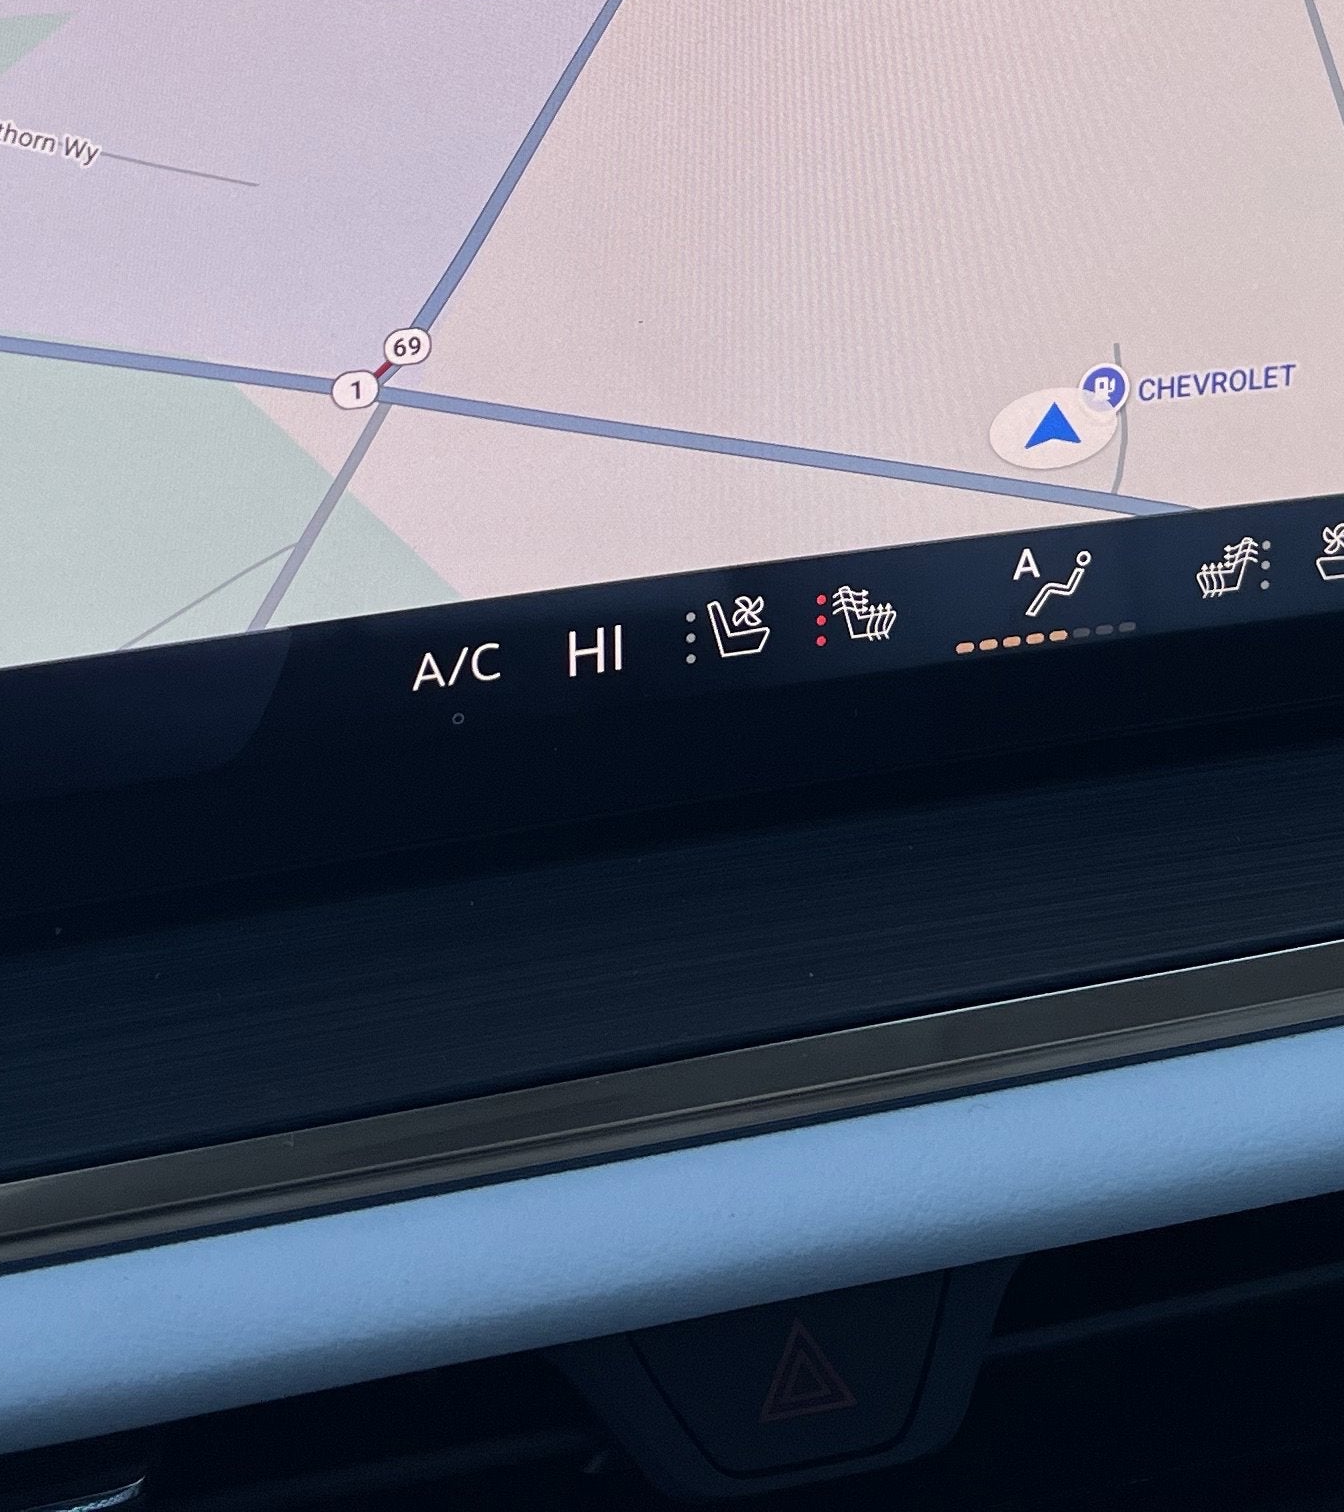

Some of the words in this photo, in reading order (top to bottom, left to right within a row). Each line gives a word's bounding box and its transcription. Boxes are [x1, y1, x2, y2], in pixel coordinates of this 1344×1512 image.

[63, 136, 99, 164] Wy
[393, 336, 422, 358] 69
[1137, 364, 1296, 401] CHEVROLET
[1012, 548, 1041, 582] A
[412, 643, 502, 692] A/C
[567, 625, 624, 678] HI
